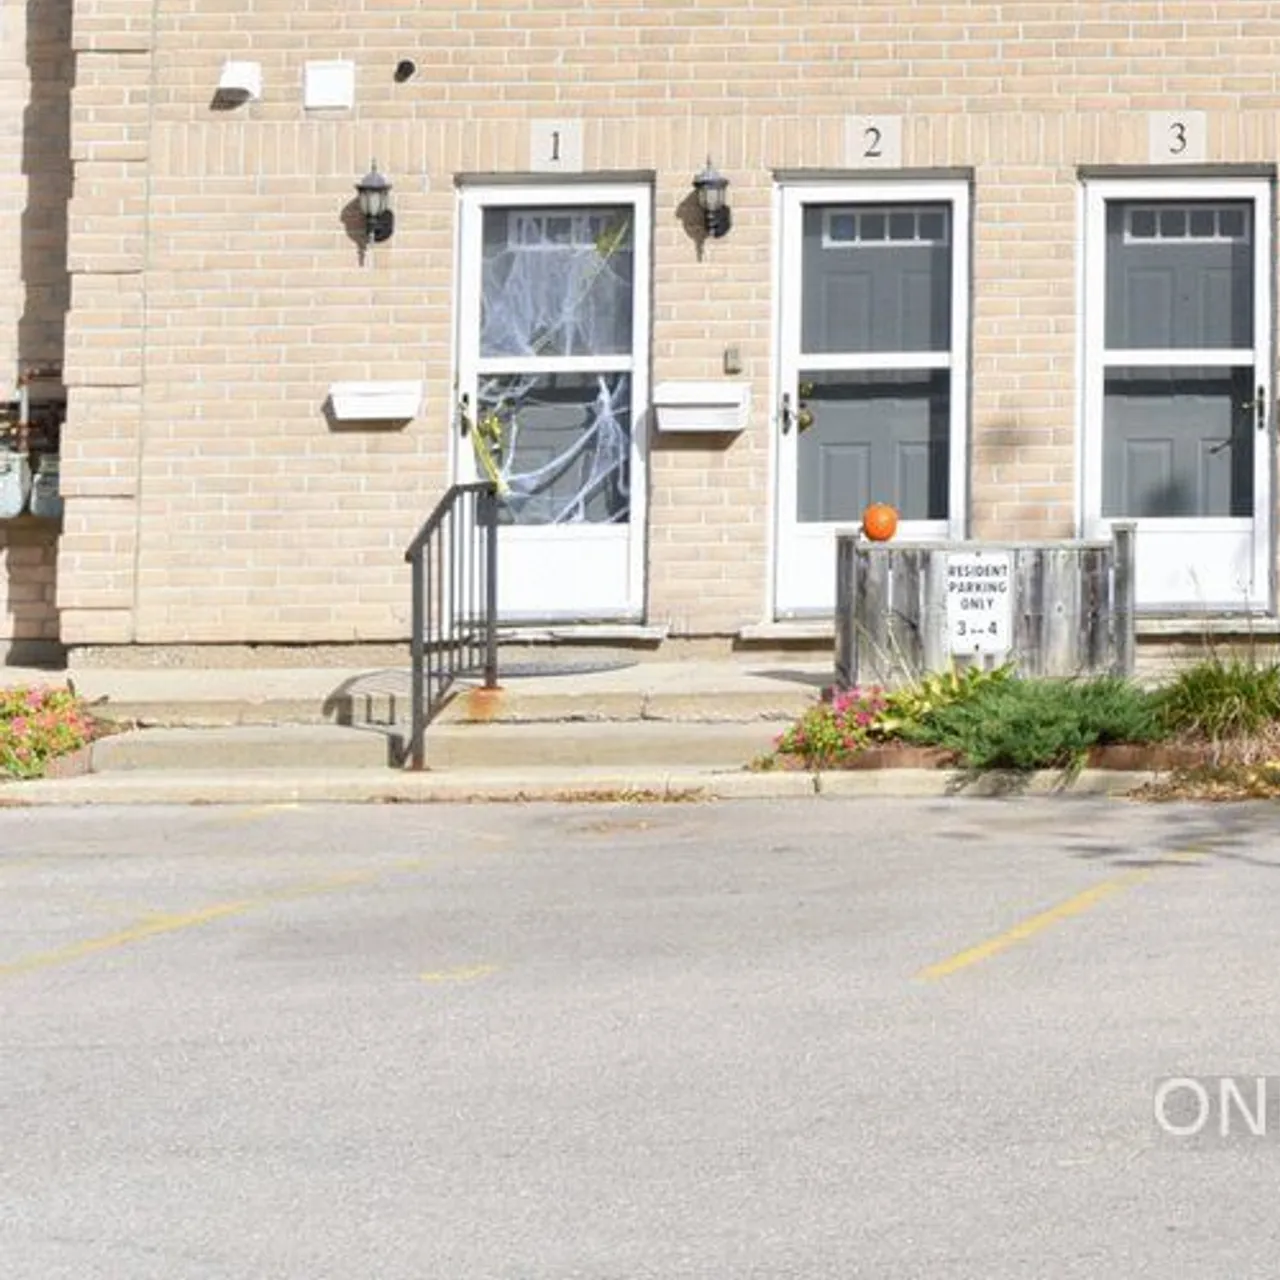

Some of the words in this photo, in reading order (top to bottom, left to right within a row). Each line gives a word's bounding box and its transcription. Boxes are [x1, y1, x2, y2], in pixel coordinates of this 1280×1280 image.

[549, 130, 561, 162] 1
[862, 126, 883, 159] 2
[1168, 122, 1187, 156] 3
[948, 565, 1008, 577] RESIDENT
[948, 581, 1007, 593] PARKING
[960, 598, 995, 611] ONLY
